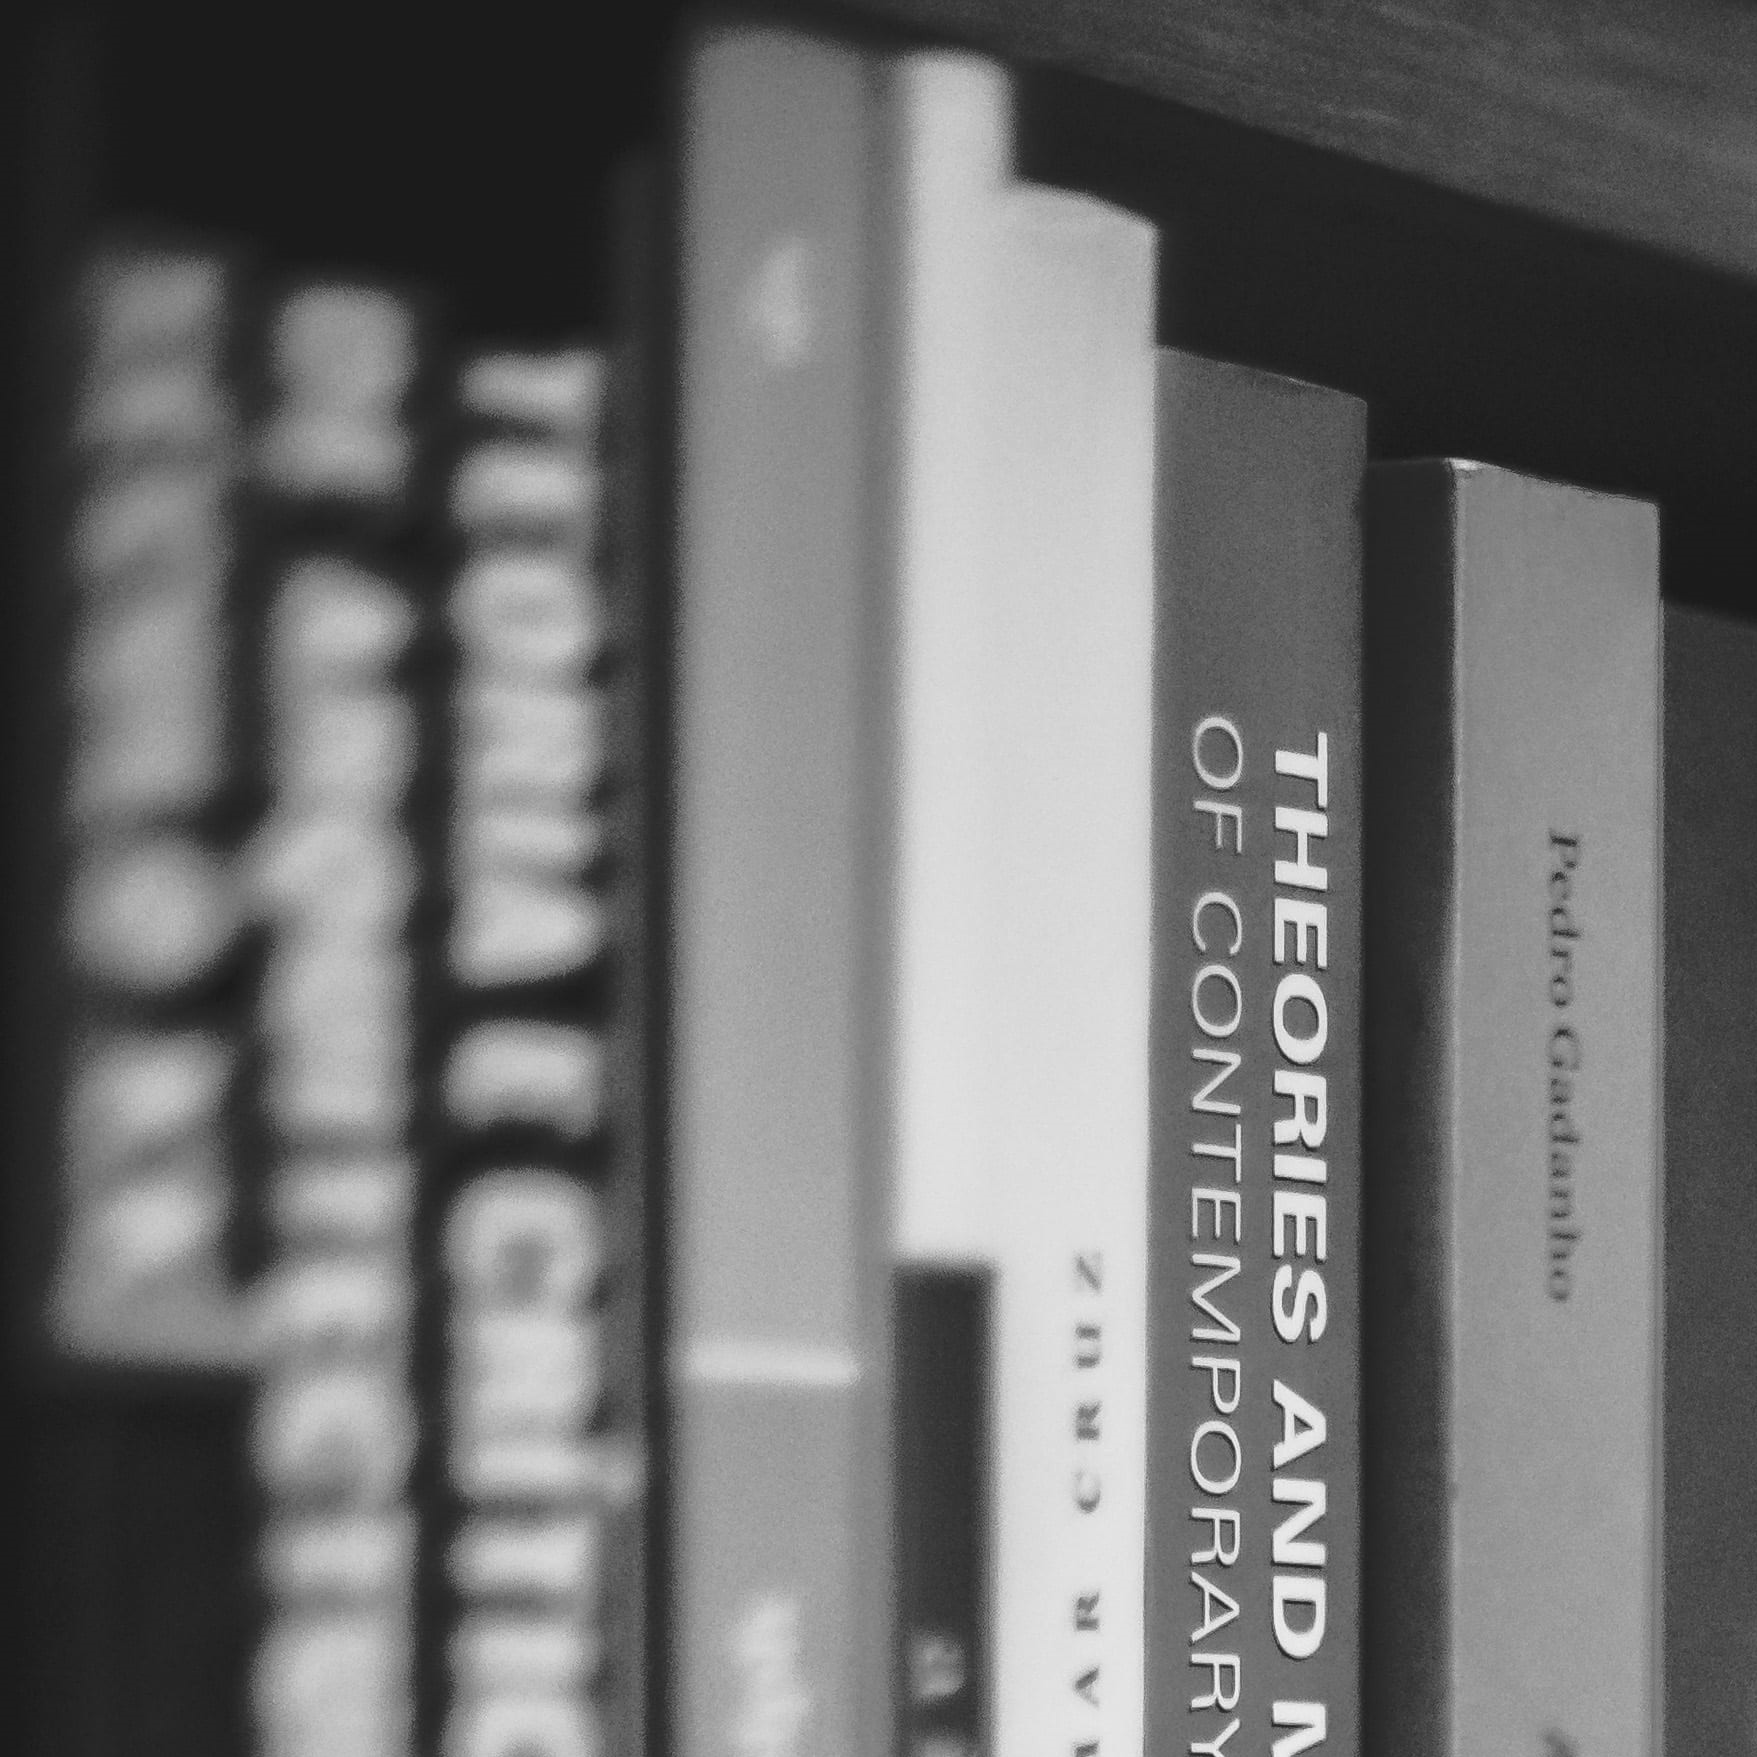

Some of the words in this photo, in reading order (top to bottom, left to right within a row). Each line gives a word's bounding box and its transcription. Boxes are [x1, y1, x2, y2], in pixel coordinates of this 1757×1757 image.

[1192, 715, 1244, 853] OF
[1270, 730, 1328, 1343] THEORIES
[1547, 830, 1583, 1008] Pedro
[1547, 1027, 1583, 1303] Gadanho
[1070, 1251, 1101, 1514] CRUZ
[1270, 1380, 1328, 1659] AND
